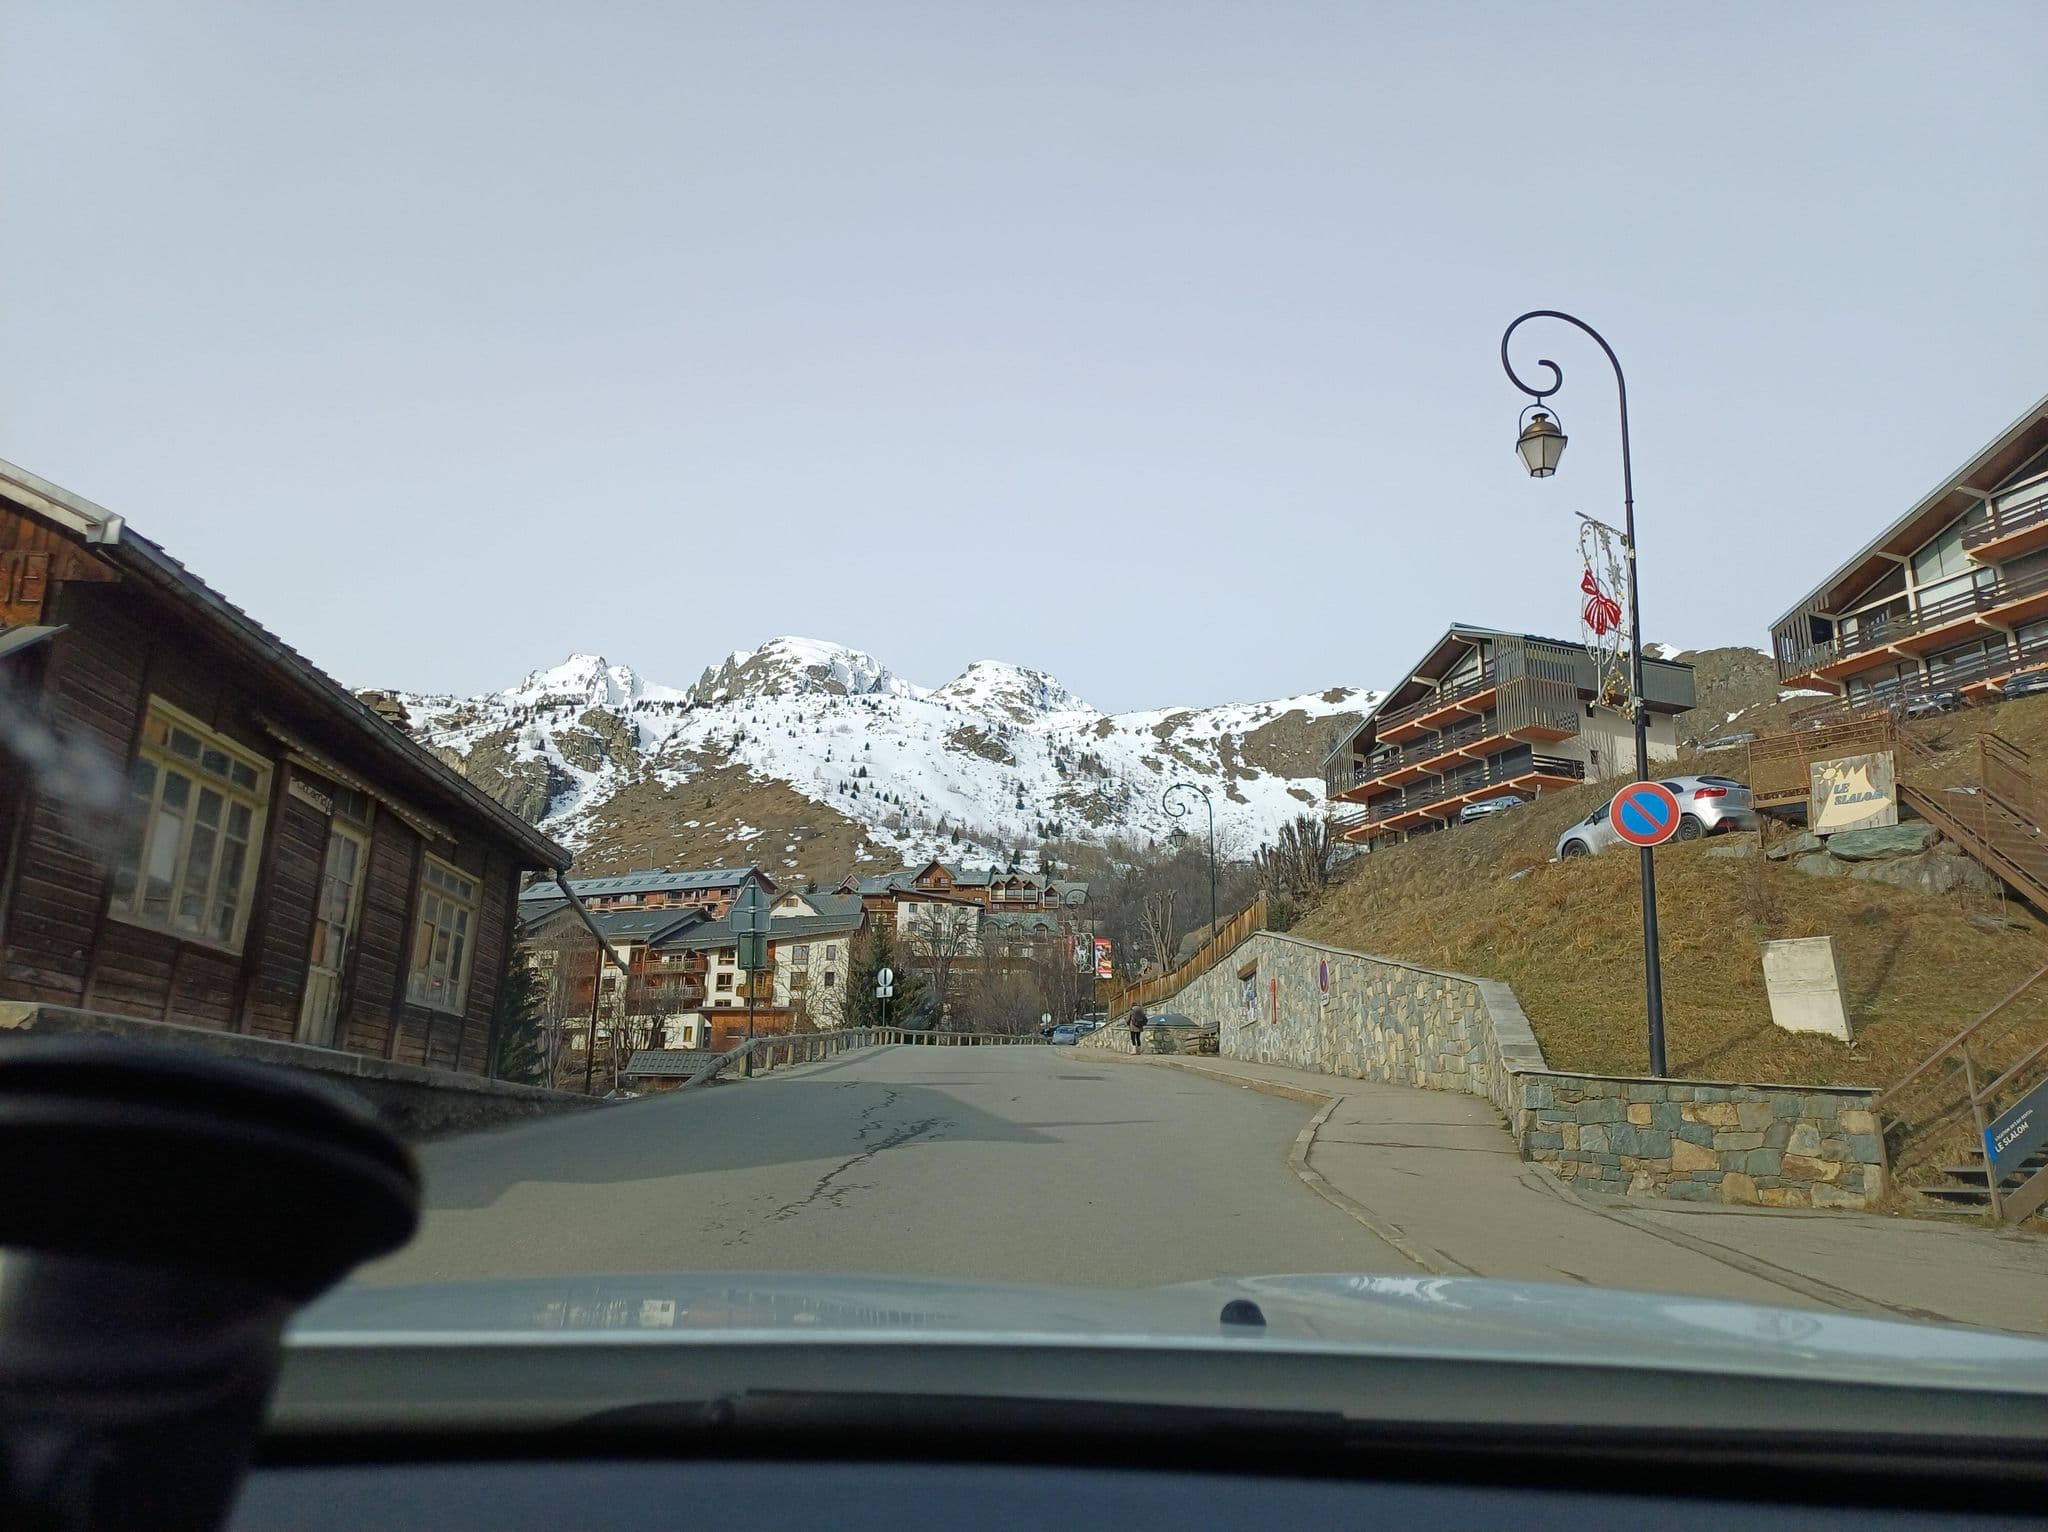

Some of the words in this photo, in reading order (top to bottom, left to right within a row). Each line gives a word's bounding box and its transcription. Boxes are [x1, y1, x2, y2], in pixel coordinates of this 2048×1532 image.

[1834, 783, 1850, 794] LE
[1995, 1141, 2005, 1153] LE
[2003, 1121, 2029, 1146] SLALOM
